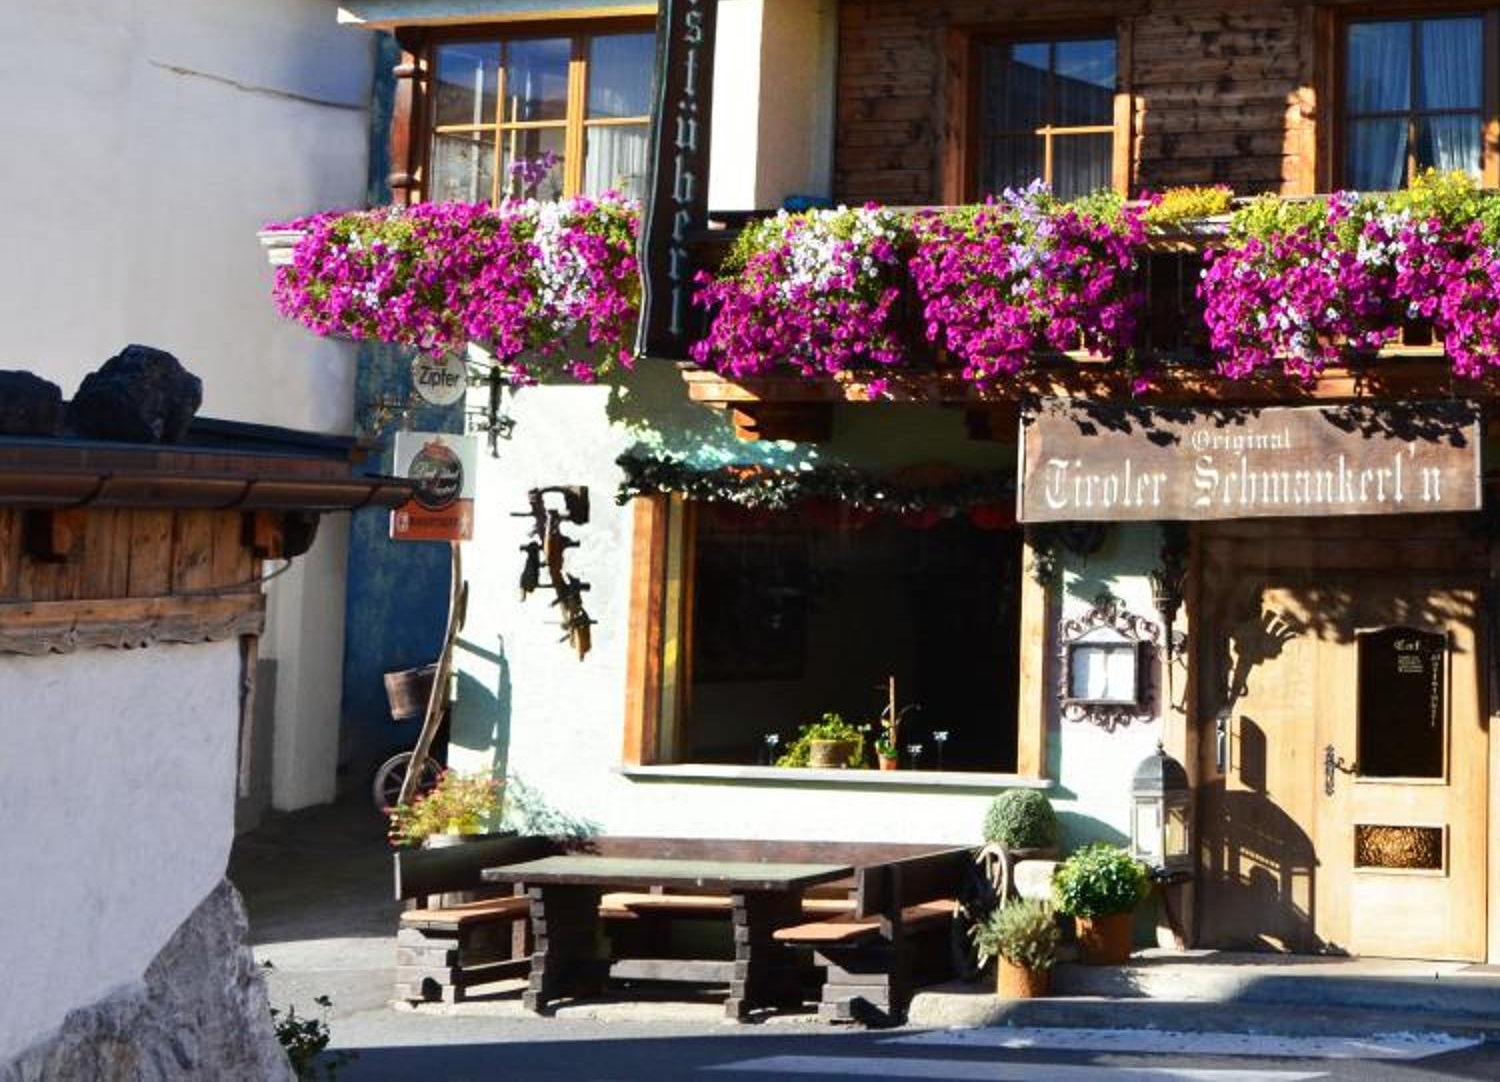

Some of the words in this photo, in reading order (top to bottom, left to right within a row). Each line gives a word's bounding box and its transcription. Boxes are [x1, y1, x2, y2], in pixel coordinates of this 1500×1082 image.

[419, 366, 460, 388] Zipfer
[1190, 427, 1292, 455] Original
[1044, 458, 1168, 509] Tiroler
